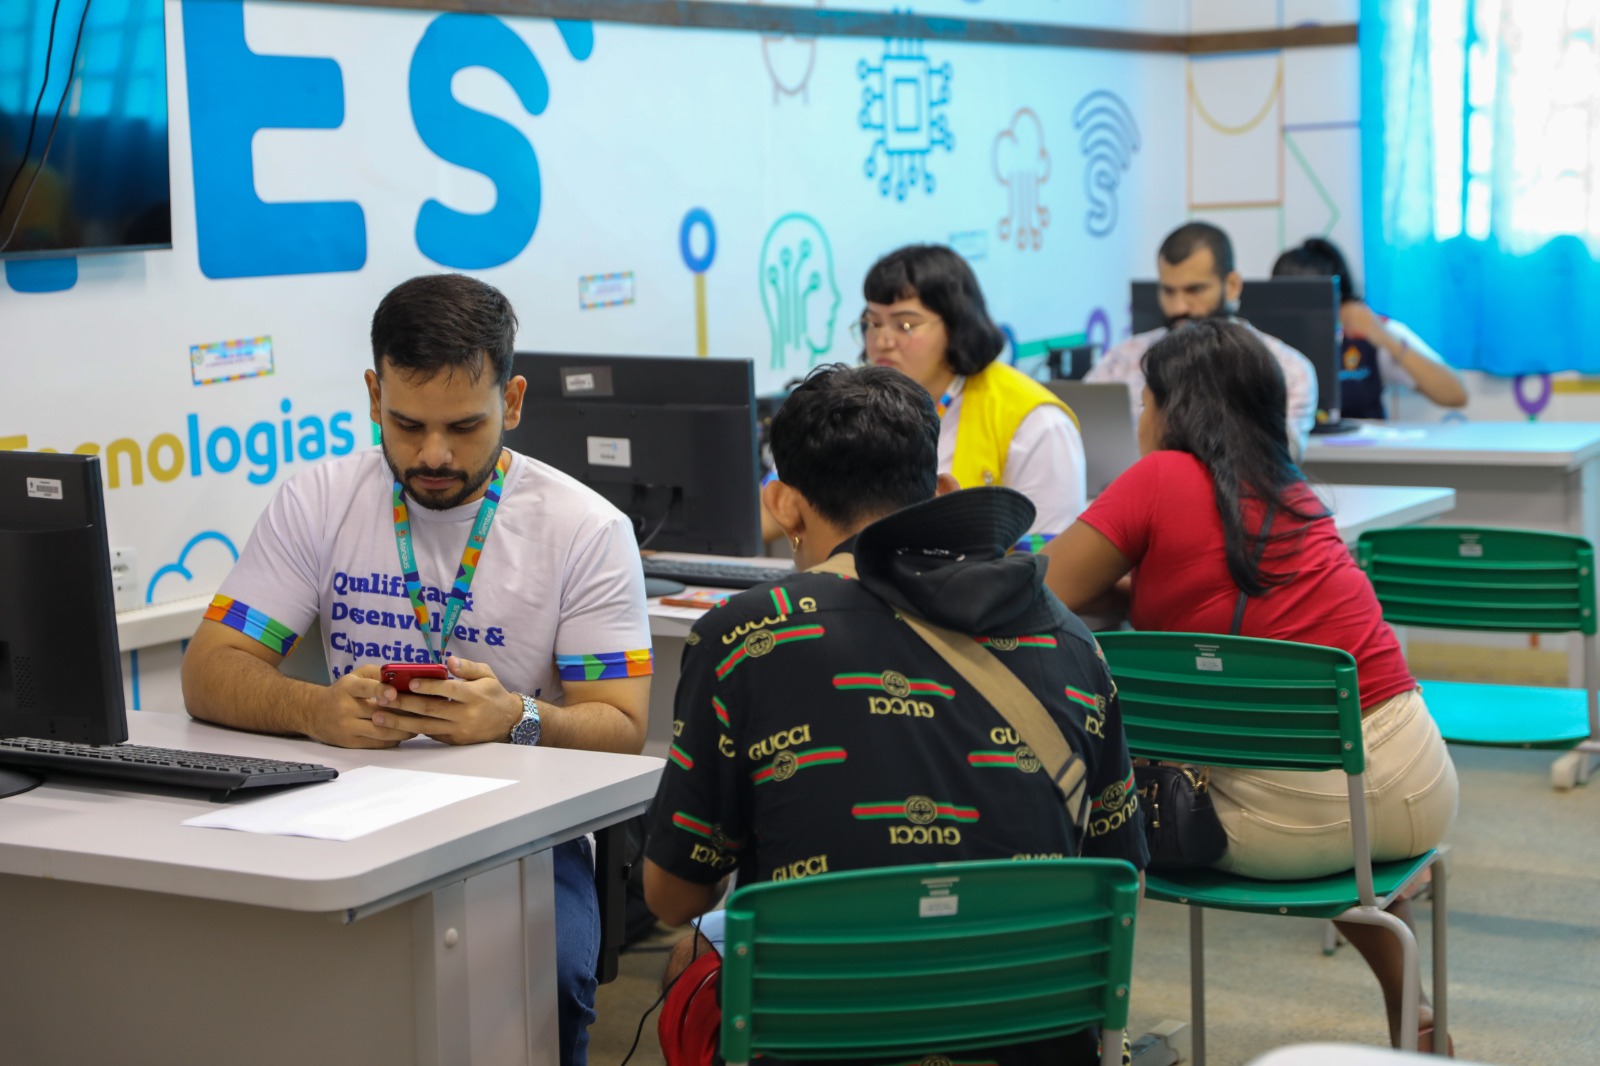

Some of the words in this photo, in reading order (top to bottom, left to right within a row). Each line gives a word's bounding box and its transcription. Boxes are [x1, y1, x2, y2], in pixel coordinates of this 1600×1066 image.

[0, 398, 354, 489] nologias
[398, 537, 411, 569] Manaus
[333, 572, 453, 608] Qualifiar
[484, 626, 506, 647] &
[868, 696, 935, 719] GUCCI
[748, 724, 812, 761] GUCCI
[1089, 794, 1138, 838] GUCCI
[888, 826, 961, 846] GUCCI
[772, 854, 829, 883] GUCCI
